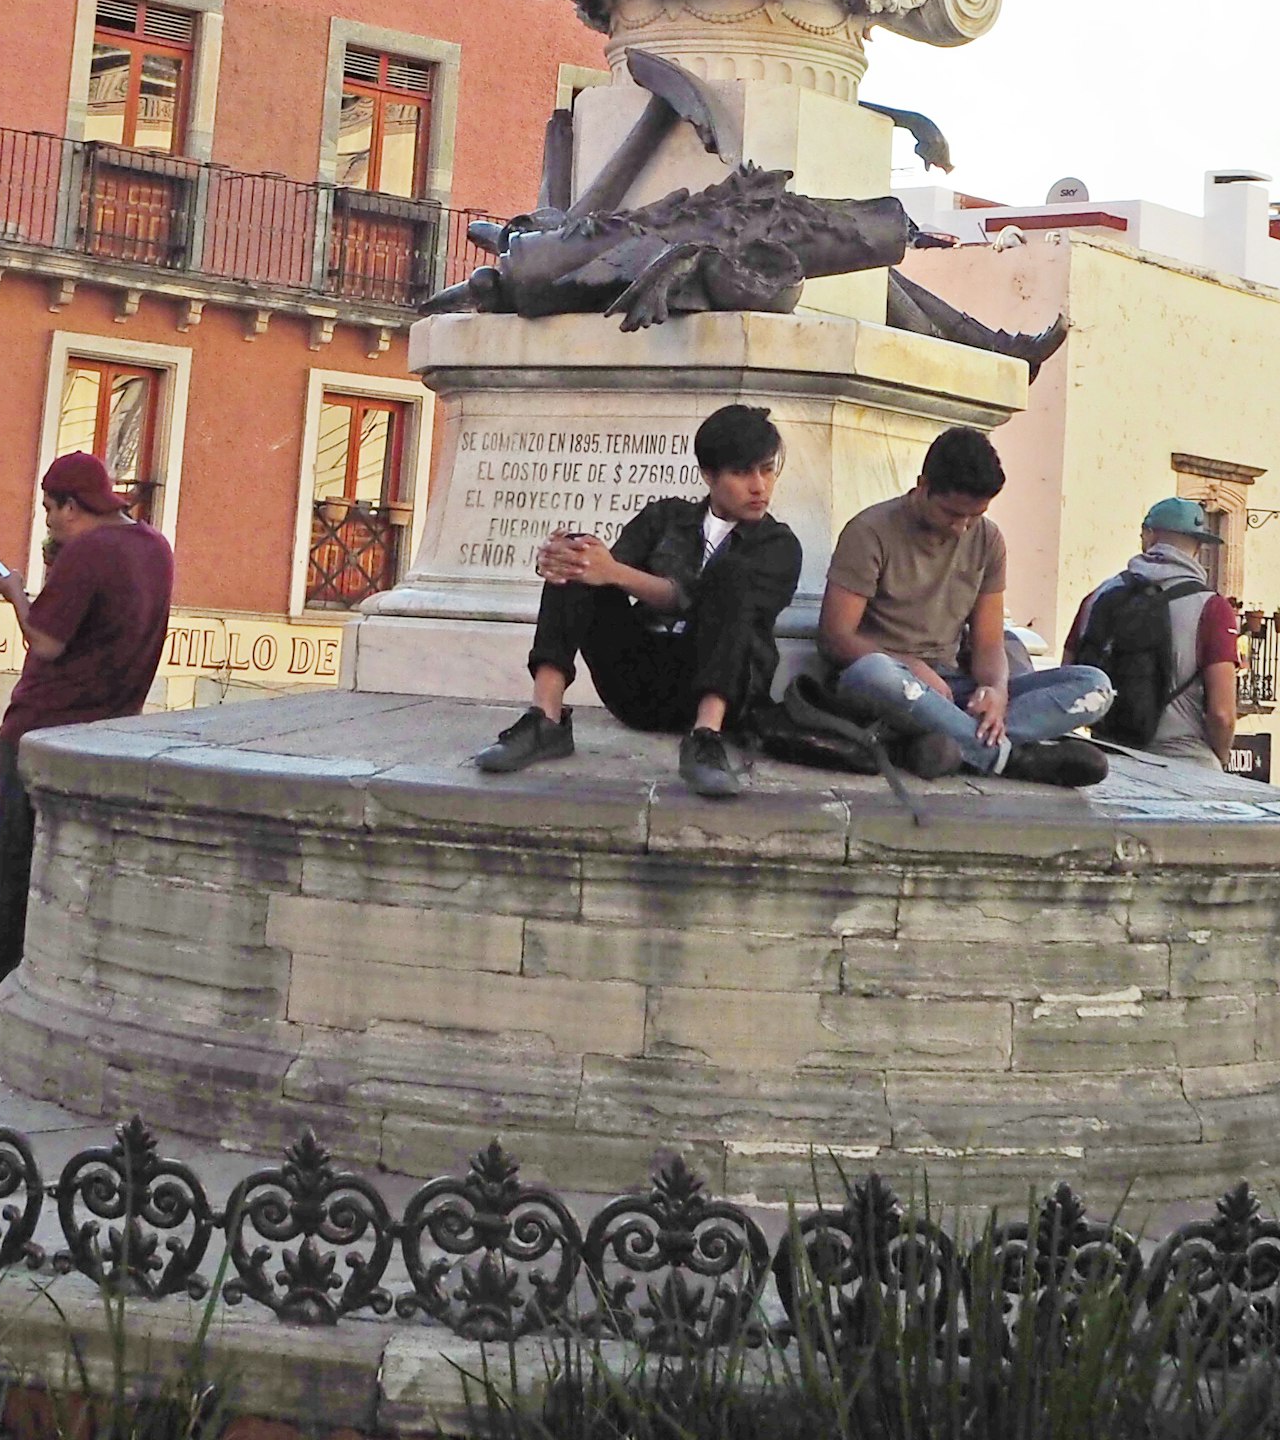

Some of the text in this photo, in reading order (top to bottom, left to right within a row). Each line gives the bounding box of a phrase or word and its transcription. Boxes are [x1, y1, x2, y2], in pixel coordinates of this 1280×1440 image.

[1060, 189, 1078, 197] SKY
[461, 432, 689, 455] SE COMENZO EN 1895. TERMINO EN
[477, 461, 495, 481] EL
[501, 462, 548, 482] COSTO
[552, 463, 583, 483] FUE
[587, 463, 607, 483] DE
[465, 490, 485, 508] EL
[493, 491, 585, 511] PROYECTO
[594, 493, 602, 511] Y
[488, 518, 550, 538] FUERON
[459, 538, 516, 568] SEÑOR
[164, 627, 280, 672] TILLO
[287, 637, 339, 676] DE
